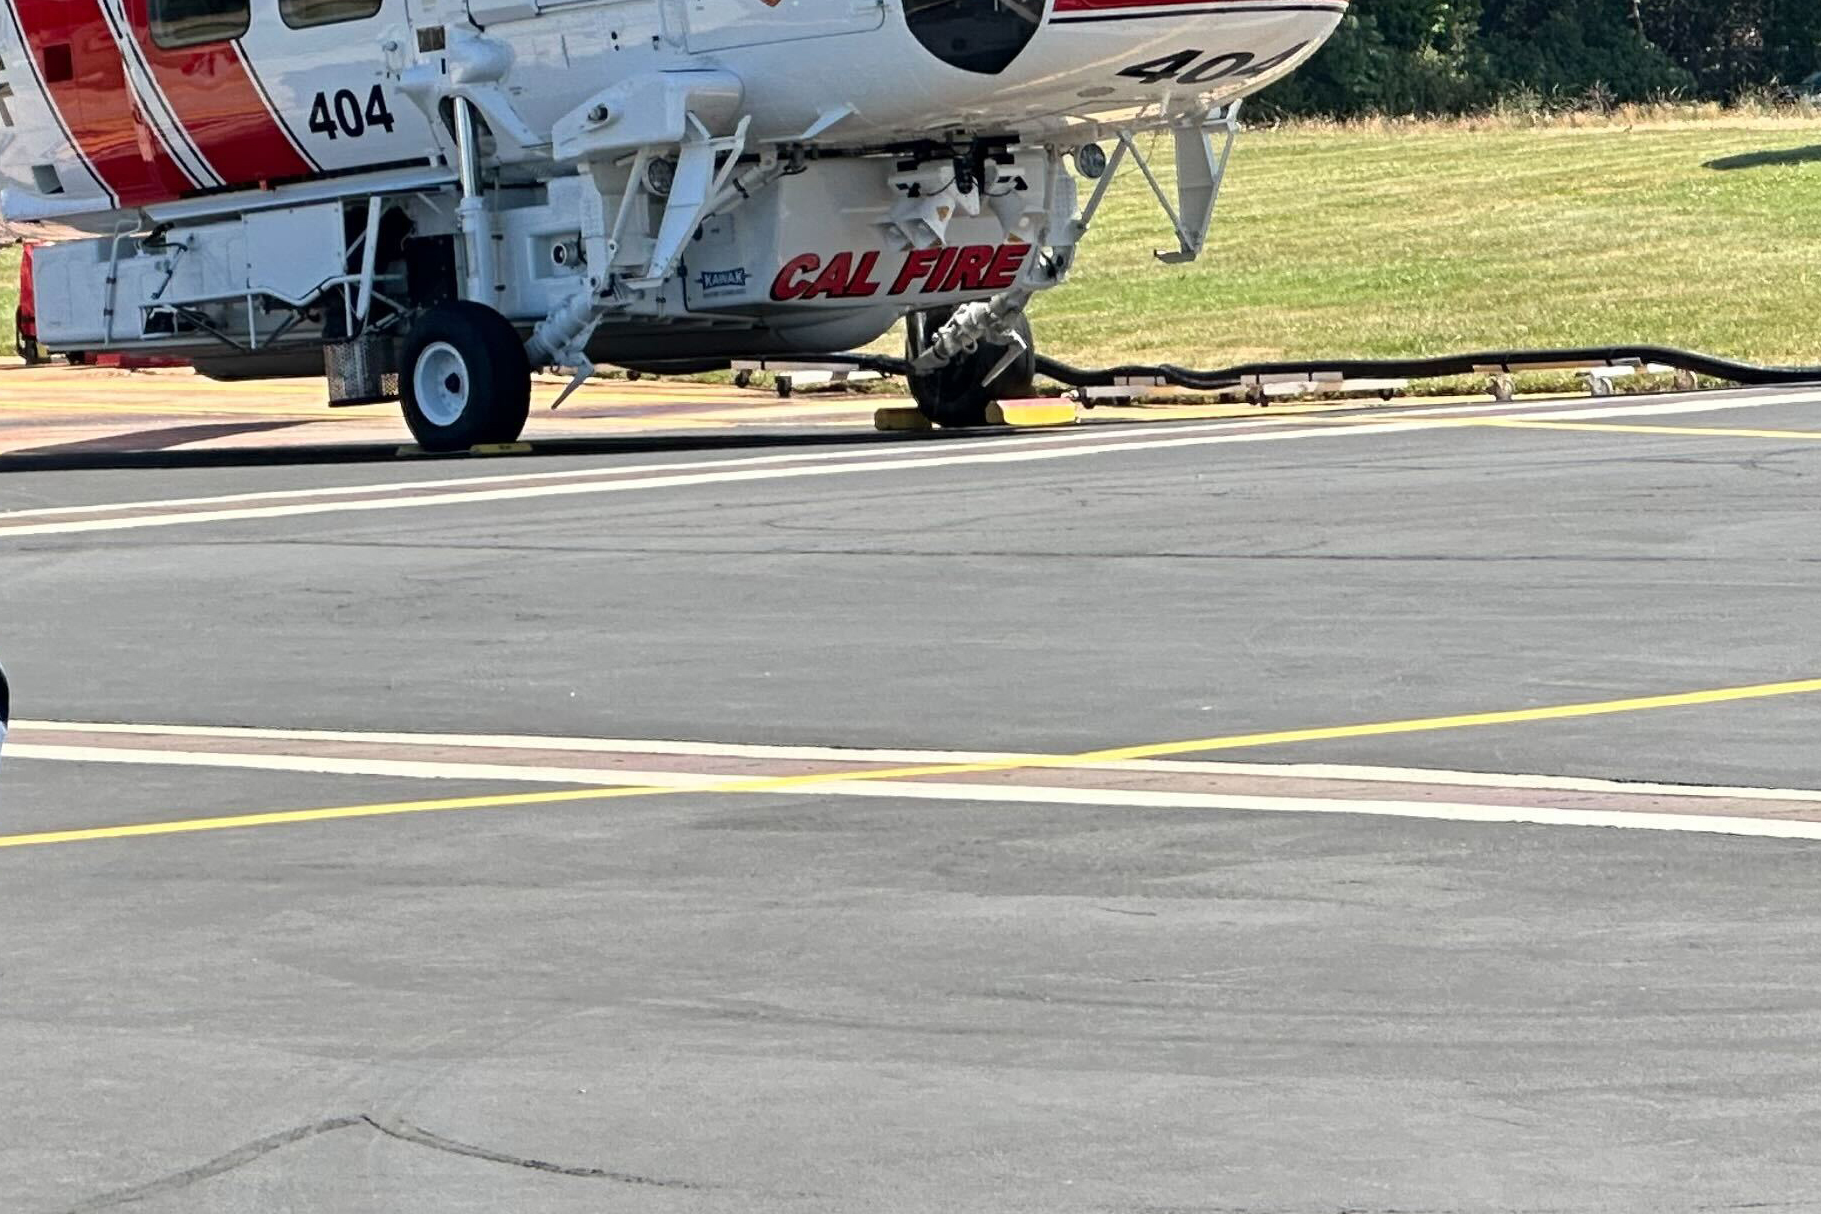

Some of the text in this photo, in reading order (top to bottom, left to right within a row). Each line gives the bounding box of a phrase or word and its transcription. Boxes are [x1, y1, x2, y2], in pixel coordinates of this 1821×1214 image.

[309, 84, 395, 140] 404
[770, 243, 1033, 302] CAL FIRE
